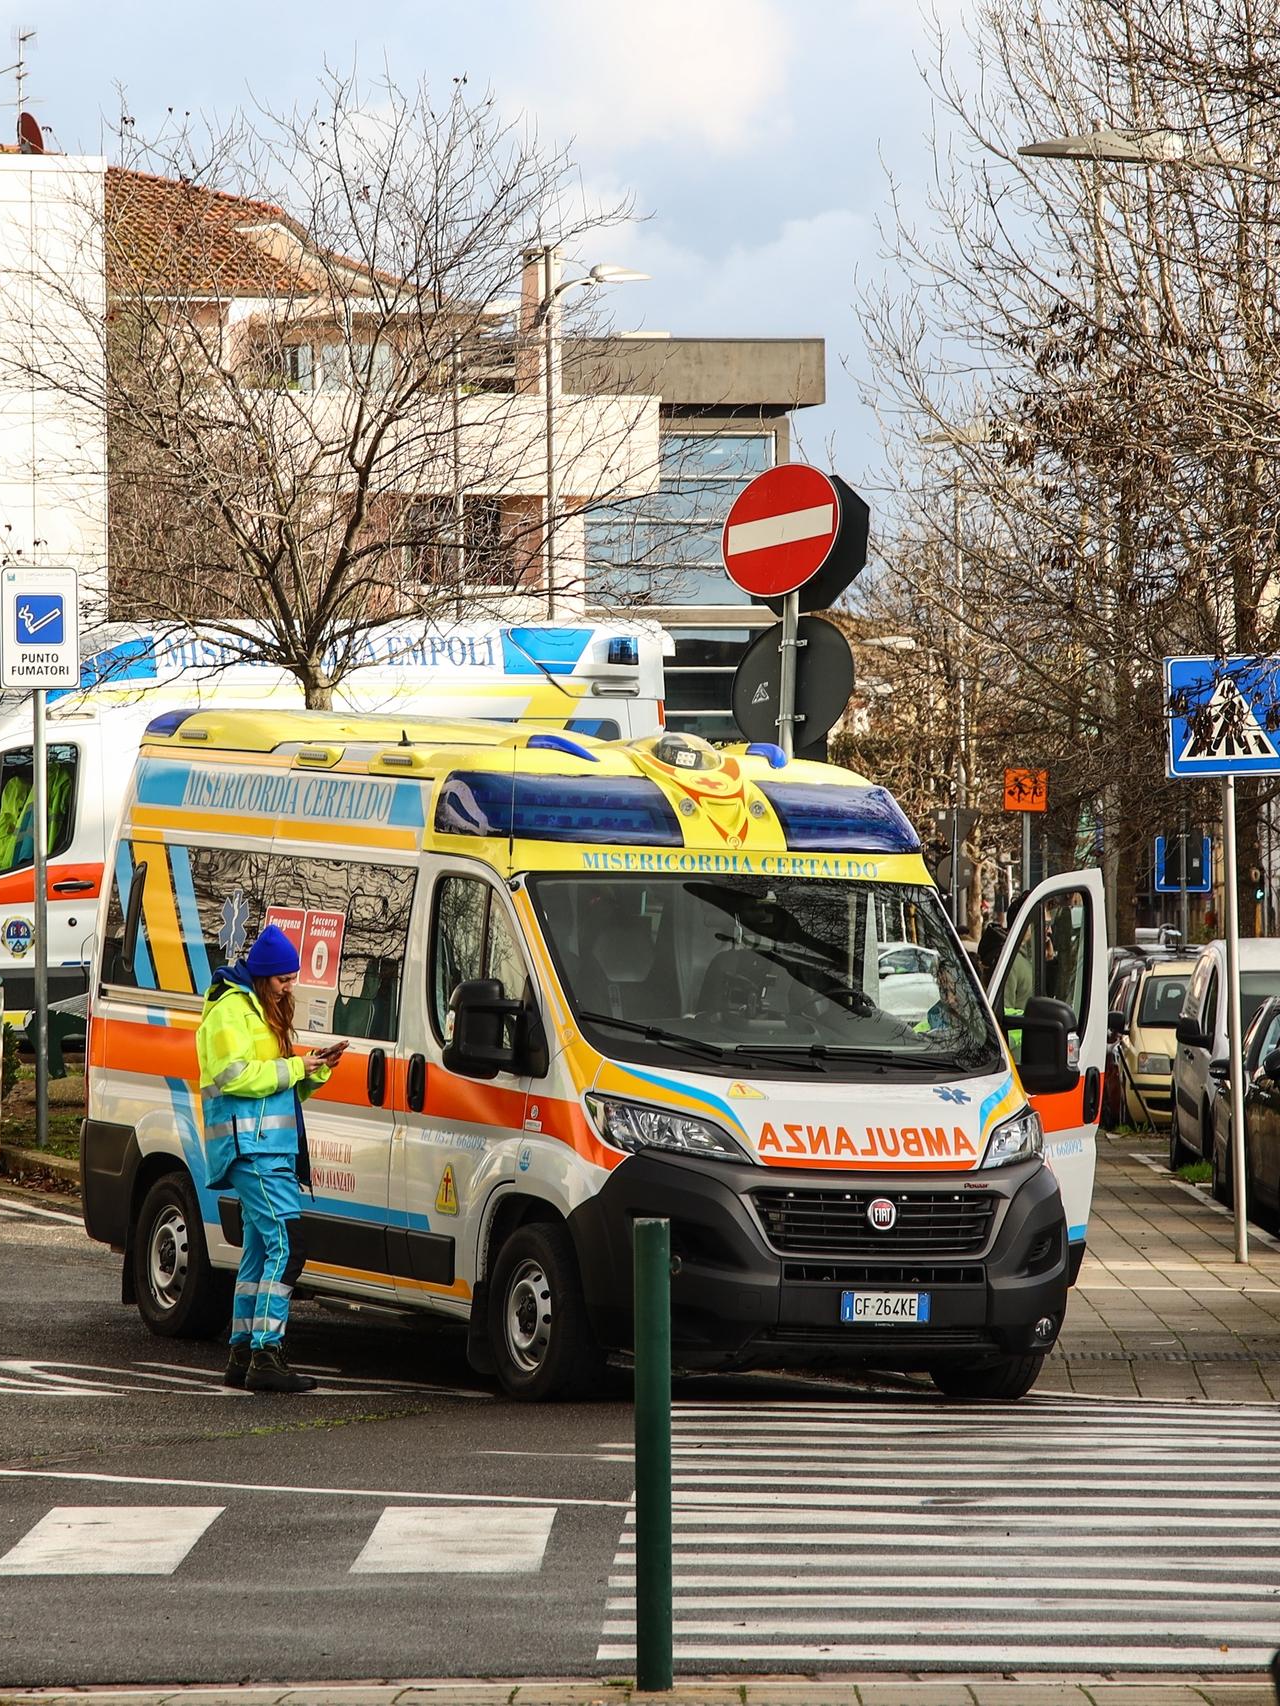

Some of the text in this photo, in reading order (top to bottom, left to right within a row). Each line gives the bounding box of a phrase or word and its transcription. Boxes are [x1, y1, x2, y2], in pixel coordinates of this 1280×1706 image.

[21, 653, 59, 663] PUNTO
[387, 636, 495, 667] EMPOLI
[11, 665, 70, 676] FUMATORI
[183, 769, 393, 821] MISERICORDIA CERTALDO
[582, 852, 879, 879] MISERICORDIA CERTALDO
[268, 915, 301, 931] Emergenza
[311, 915, 338, 927] Soccorso
[310, 926, 337, 938] Sanitario
[320, 1140, 343, 1162] MOBILE
[343, 1144, 352, 1164] DI
[325, 1169, 356, 1193] AVANZATO
[874, 1207, 890, 1223] FIAT
